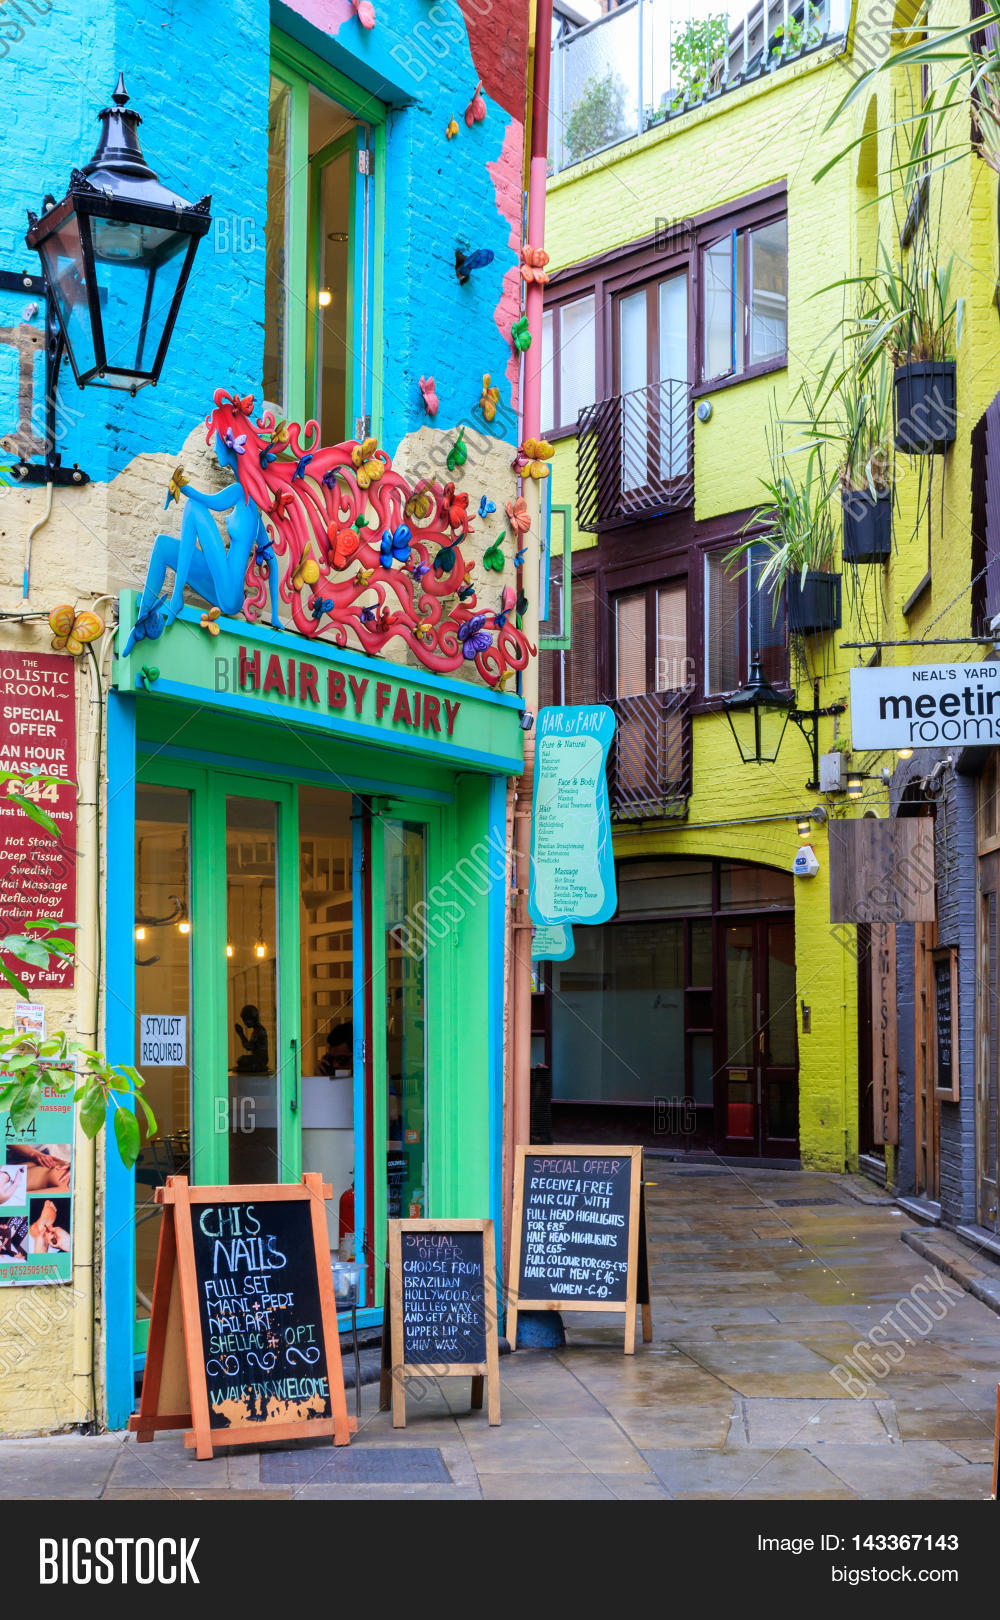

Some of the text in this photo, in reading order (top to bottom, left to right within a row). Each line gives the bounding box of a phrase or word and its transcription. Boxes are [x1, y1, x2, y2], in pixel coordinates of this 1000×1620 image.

[21, 659, 38, 668] THE
[912, 667, 998, 682] NEAL'S YARD
[5, 682, 55, 698] ROOM
[238, 645, 462, 736] HAIR BY FAIRY
[3, 706, 63, 722] SPECIAL
[9, 722, 56, 737] OFFER
[541, 711, 564, 735] HAIR
[575, 711, 607, 734] FAIRY
[0, 744, 65, 760] AN HOUR
[557, 778, 570, 786] Face
[580, 777, 596, 788] Body
[5, 837, 58, 847] Hot Stone
[0, 851, 63, 863] Deep Tissue
[10, 865, 52, 876] Swedish
[554, 867, 579, 877] Massage
[22, 880, 68, 893] Massage
[0, 893, 62, 906] Reflexology
[0, 908, 64, 918] Indian Head
[21, 971, 36, 983] By
[38, 971, 66, 983] Fairy
[146, 1017, 182, 1036] STYLIST
[143, 1042, 183, 1064] REQUIRED
[532, 1159, 621, 1175] SPECIAL OFFER
[530, 1177, 615, 1196] RECEIVE A FREE
[530, 1194, 611, 1209] HAIR CUT WITH
[526, 1208, 625, 1227] FULL HEAD HIGHLIGHTS
[528, 1221, 545, 1231] FOR
[406, 1234, 459, 1248] SPECIAL
[526, 1231, 618, 1247] HALF HEAD HIGHLIGHTS
[213, 1234, 287, 1274] NAILS
[418, 1247, 464, 1261] OFFER
[528, 1243, 546, 1255] FOR
[403, 1261, 481, 1276] CHOOSE FROM
[526, 1254, 546, 1265] FULL
[546, 1255, 580, 1268] COLOUR
[581, 1256, 597, 1269] FOR
[524, 1266, 546, 1278] HAIR
[546, 1267, 566, 1279] CUT
[569, 1268, 591, 1280] MEN
[204, 1275, 272, 1299] FULL SET
[550, 1283, 582, 1295] WOMEN
[404, 1289, 470, 1301] HOLLYWOOD
[206, 1298, 251, 1316] MANI
[261, 1293, 295, 1308] PEDI
[404, 1302, 472, 1314] FULL LEG WAX
[209, 1311, 273, 1335] NAIL ART
[403, 1313, 480, 1325] AND GET A FREE
[406, 1326, 439, 1337] UPPER
[442, 1326, 459, 1336] LIP
[209, 1333, 265, 1354] SHELLAC
[405, 1339, 458, 1351] CHIN WAX
[273, 1377, 330, 1398] WELCOME
